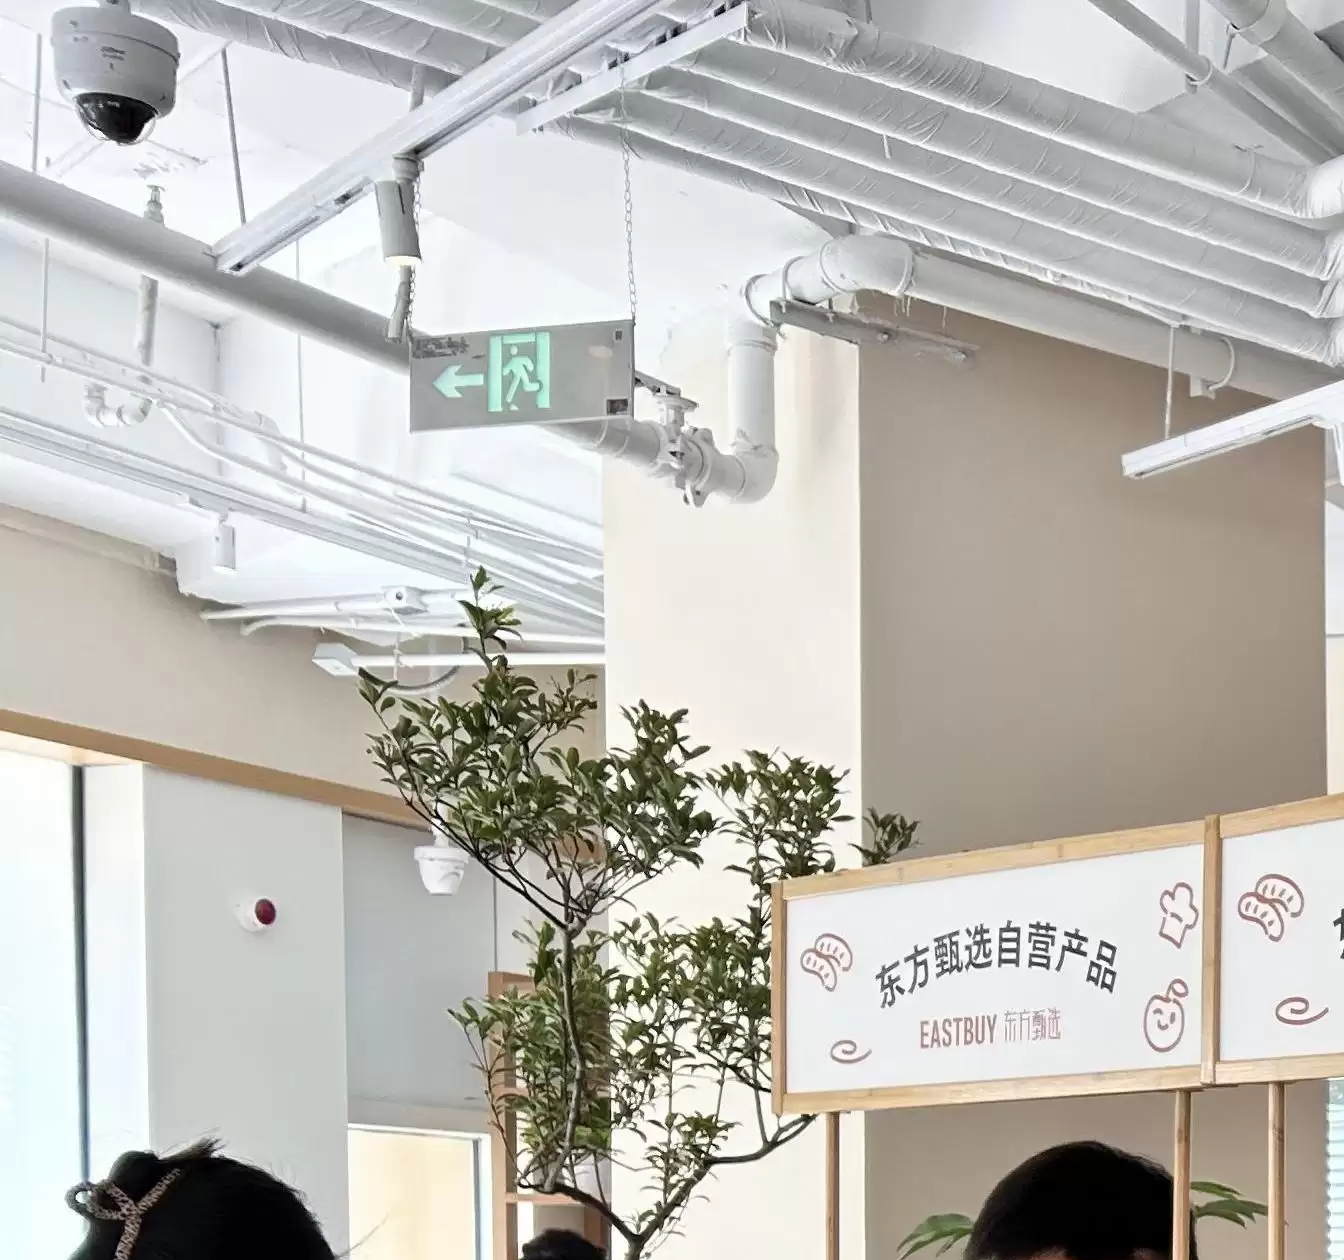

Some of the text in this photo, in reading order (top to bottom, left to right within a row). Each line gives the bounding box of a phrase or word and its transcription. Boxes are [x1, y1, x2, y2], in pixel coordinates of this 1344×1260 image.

[875, 920, 1118, 1008] 东方甄选自营产品
[919, 1008, 1062, 1050] EASTBUY 东方甄选
